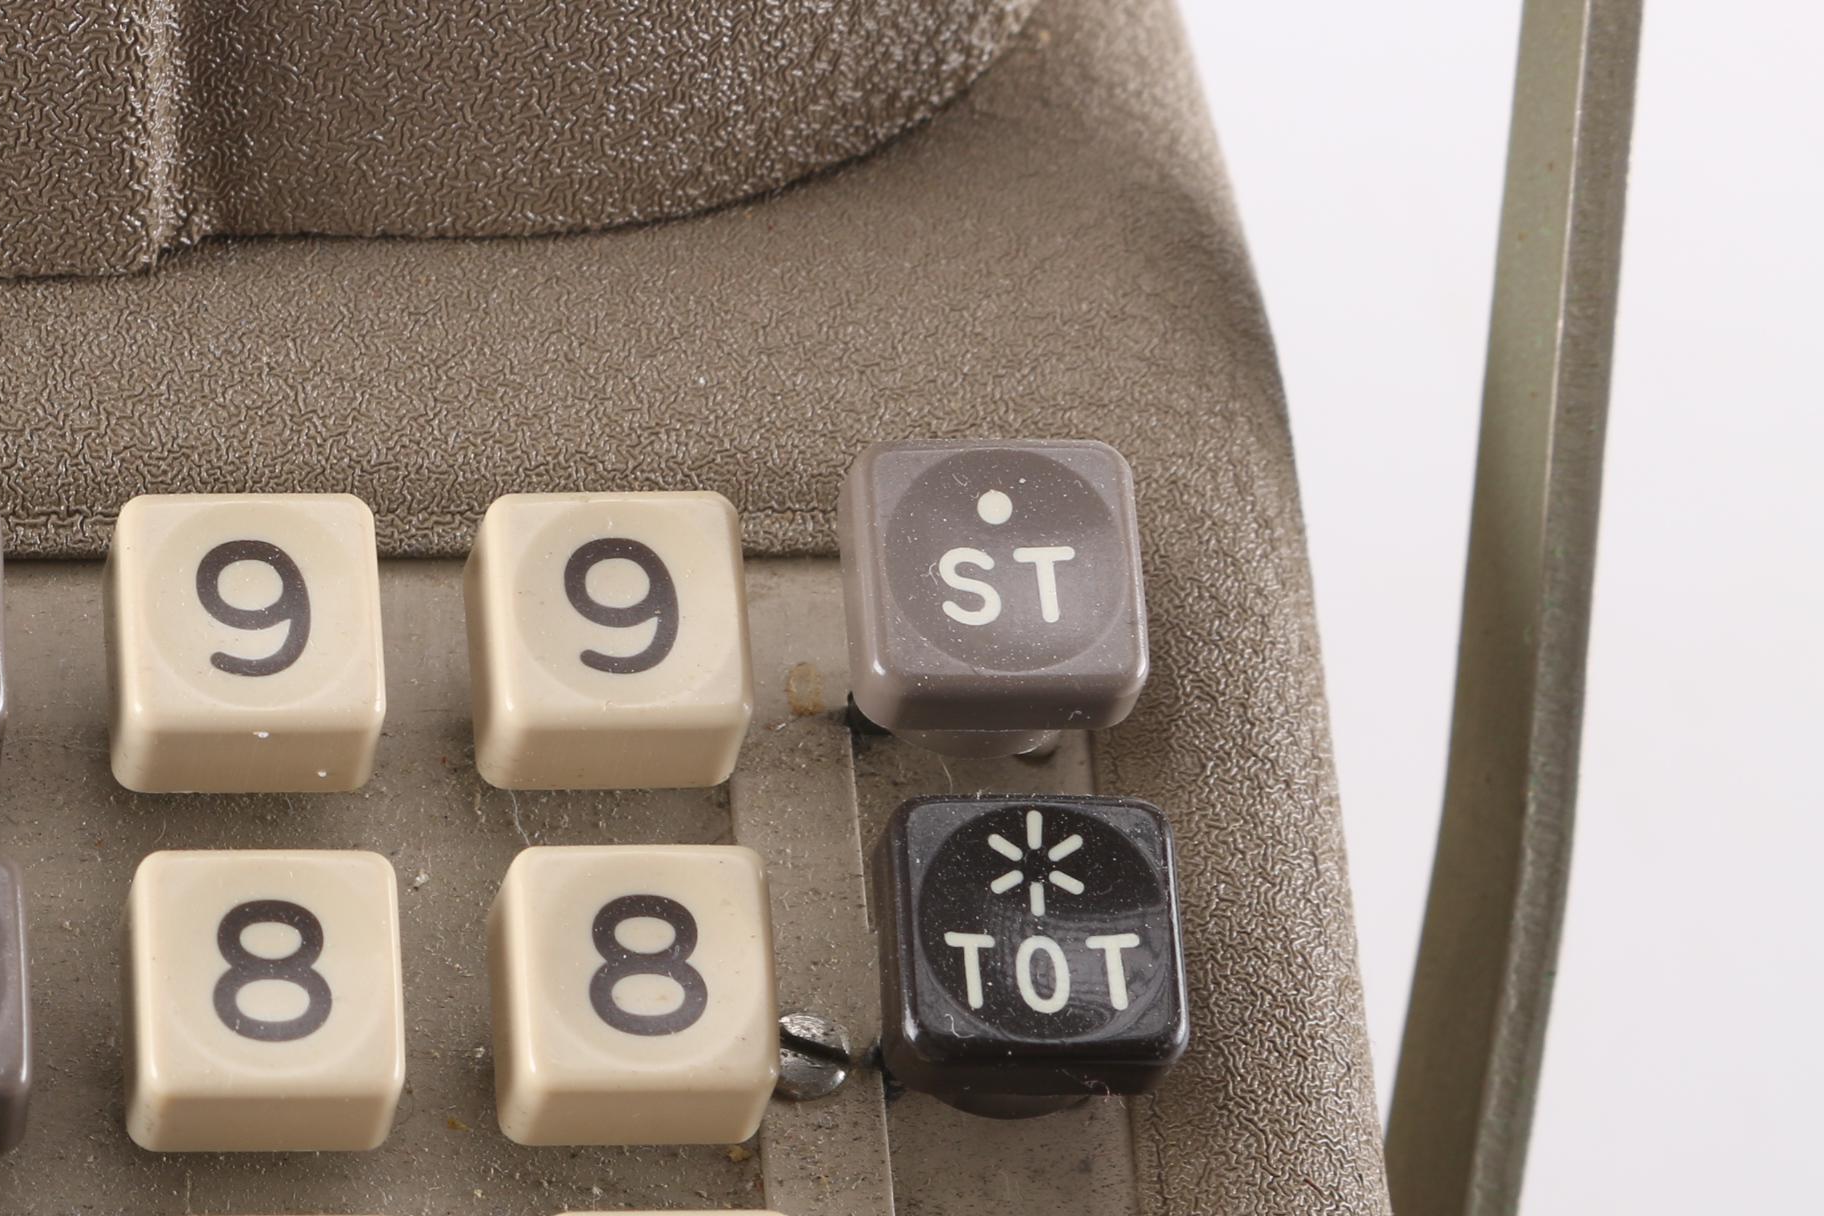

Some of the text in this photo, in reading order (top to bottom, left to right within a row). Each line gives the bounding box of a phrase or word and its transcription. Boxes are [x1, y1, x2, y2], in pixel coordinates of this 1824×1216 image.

[196, 540, 310, 677] 9
[564, 538, 679, 674] 9
[938, 545, 1076, 626] ST
[213, 899, 332, 1042] 8
[589, 894, 707, 1036] 8
[944, 931, 1141, 1014] TOT
